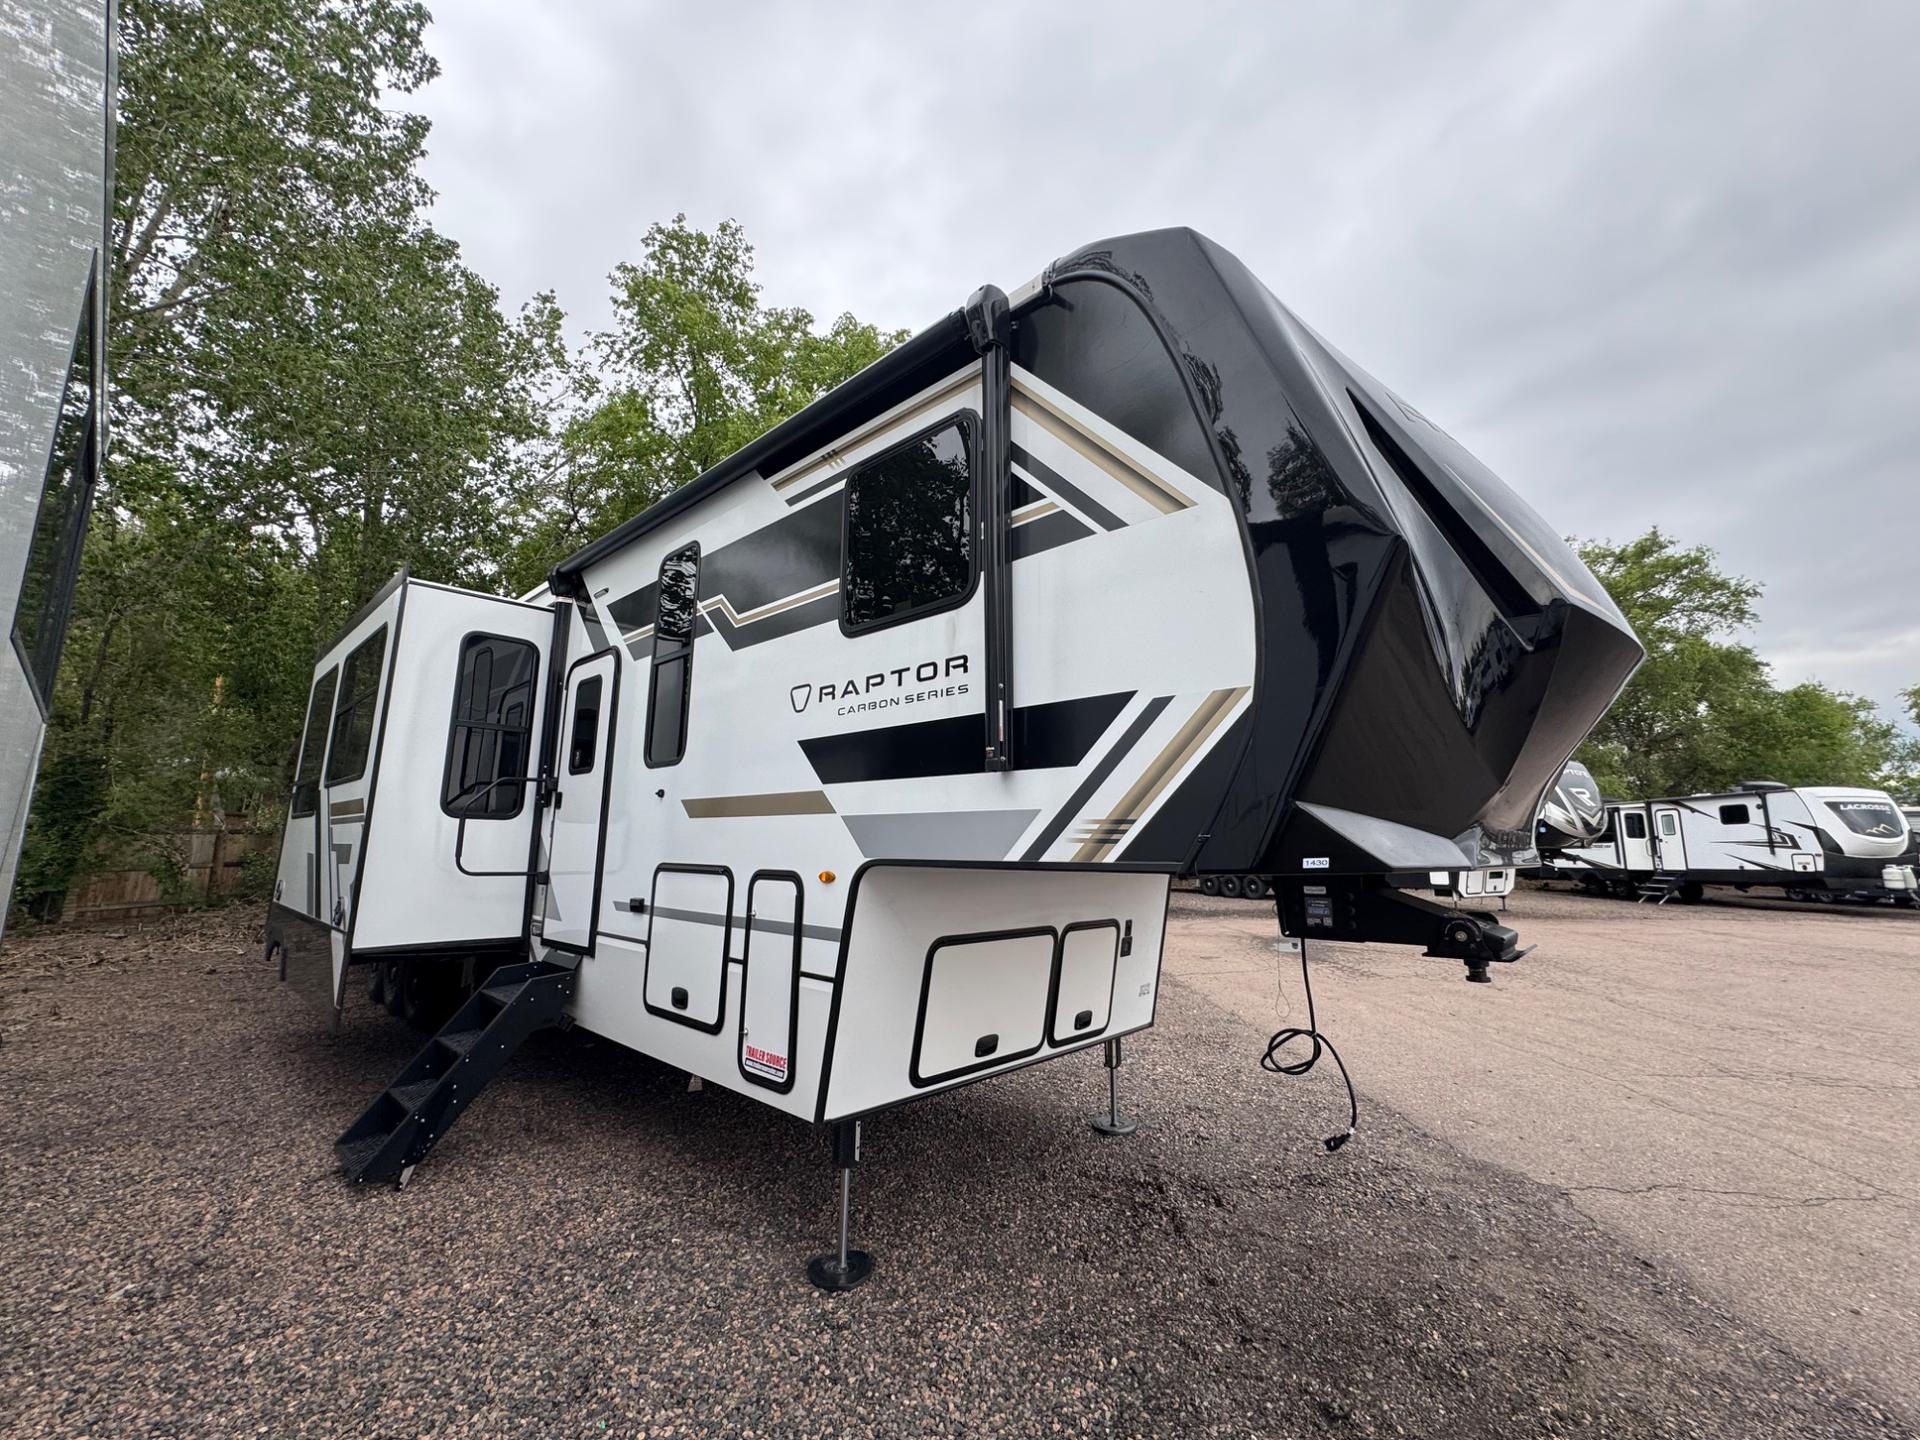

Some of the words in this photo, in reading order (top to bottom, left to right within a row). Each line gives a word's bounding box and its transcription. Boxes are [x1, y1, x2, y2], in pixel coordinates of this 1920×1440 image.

[818, 654, 969, 703] RAPTOR
[837, 696, 901, 717] CARBON
[904, 684, 969, 704] SERIES
[746, 1045, 766, 1062] TRAILER
[766, 1052, 787, 1069] SOURCE
